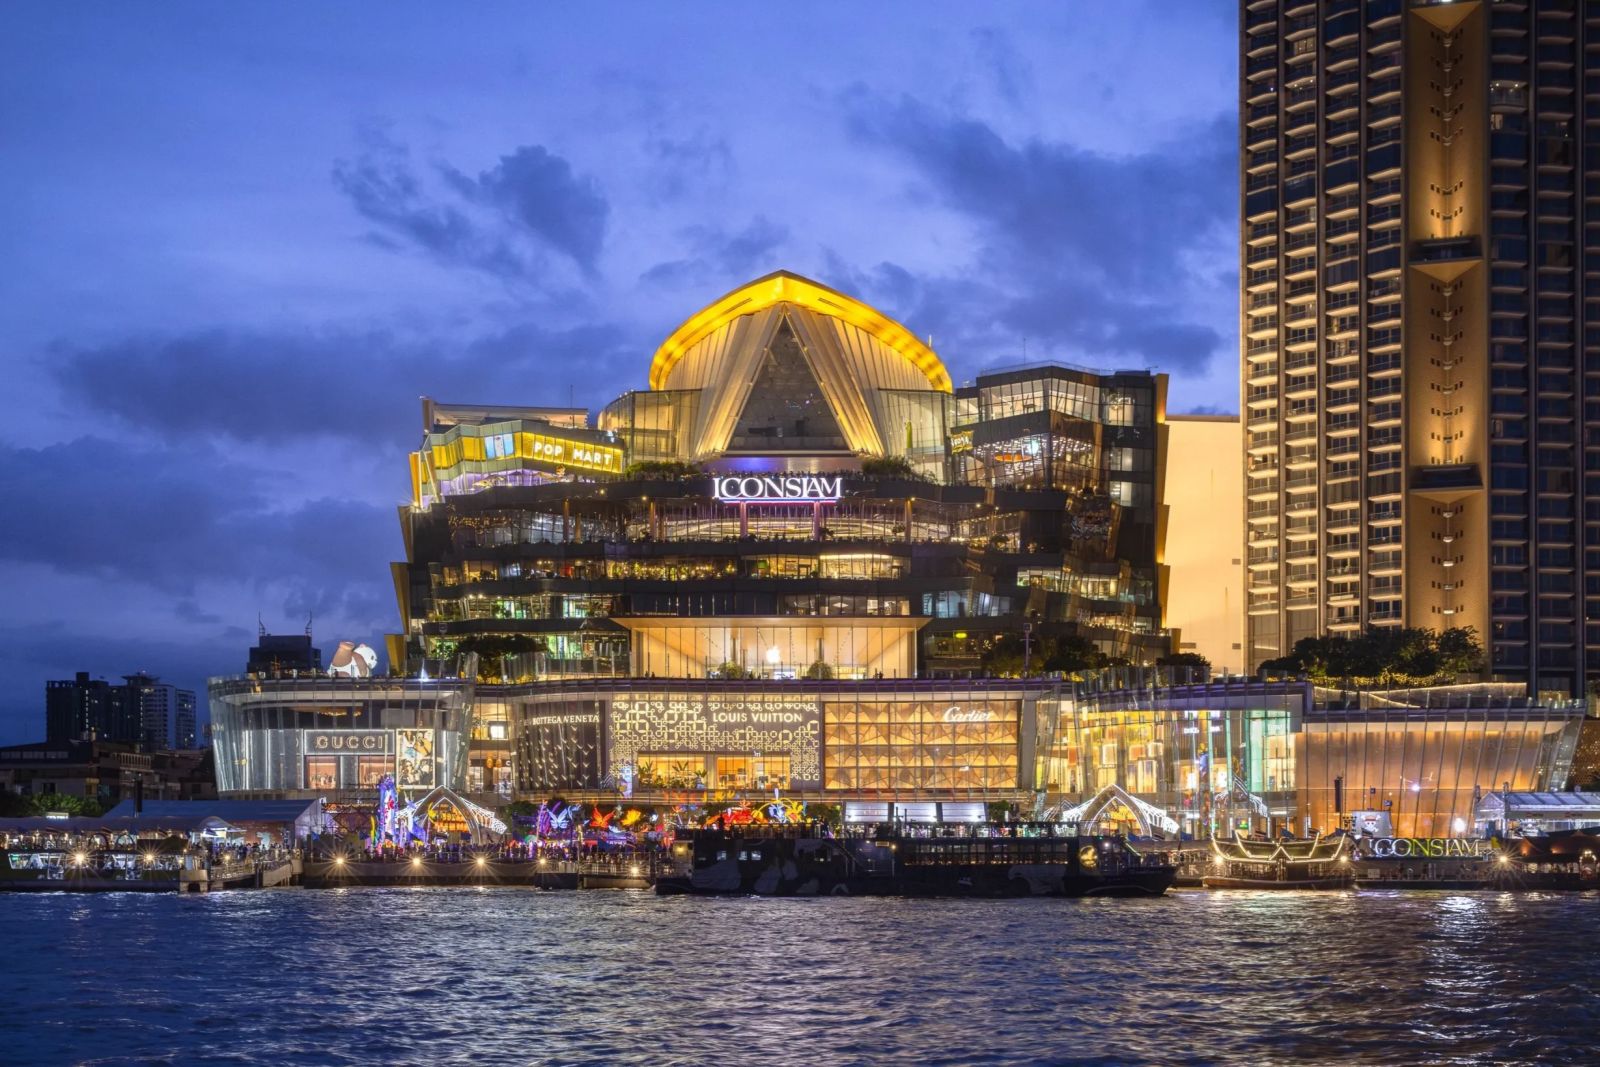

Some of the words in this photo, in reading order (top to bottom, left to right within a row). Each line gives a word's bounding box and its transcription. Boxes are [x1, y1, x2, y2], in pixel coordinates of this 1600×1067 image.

[534, 441, 563, 457] POP
[573, 448, 612, 465] MART
[712, 477, 842, 498] ICONSIAM
[532, 715, 562, 726] BOTTEGA
[563, 714, 600, 724] VENETA
[713, 712, 748, 723] LOUIS
[751, 712, 803, 723] VUITTON
[944, 706, 990, 722] Cartier
[315, 735, 383, 749] GUCCI
[1367, 838, 1481, 857] ICONSIAM
